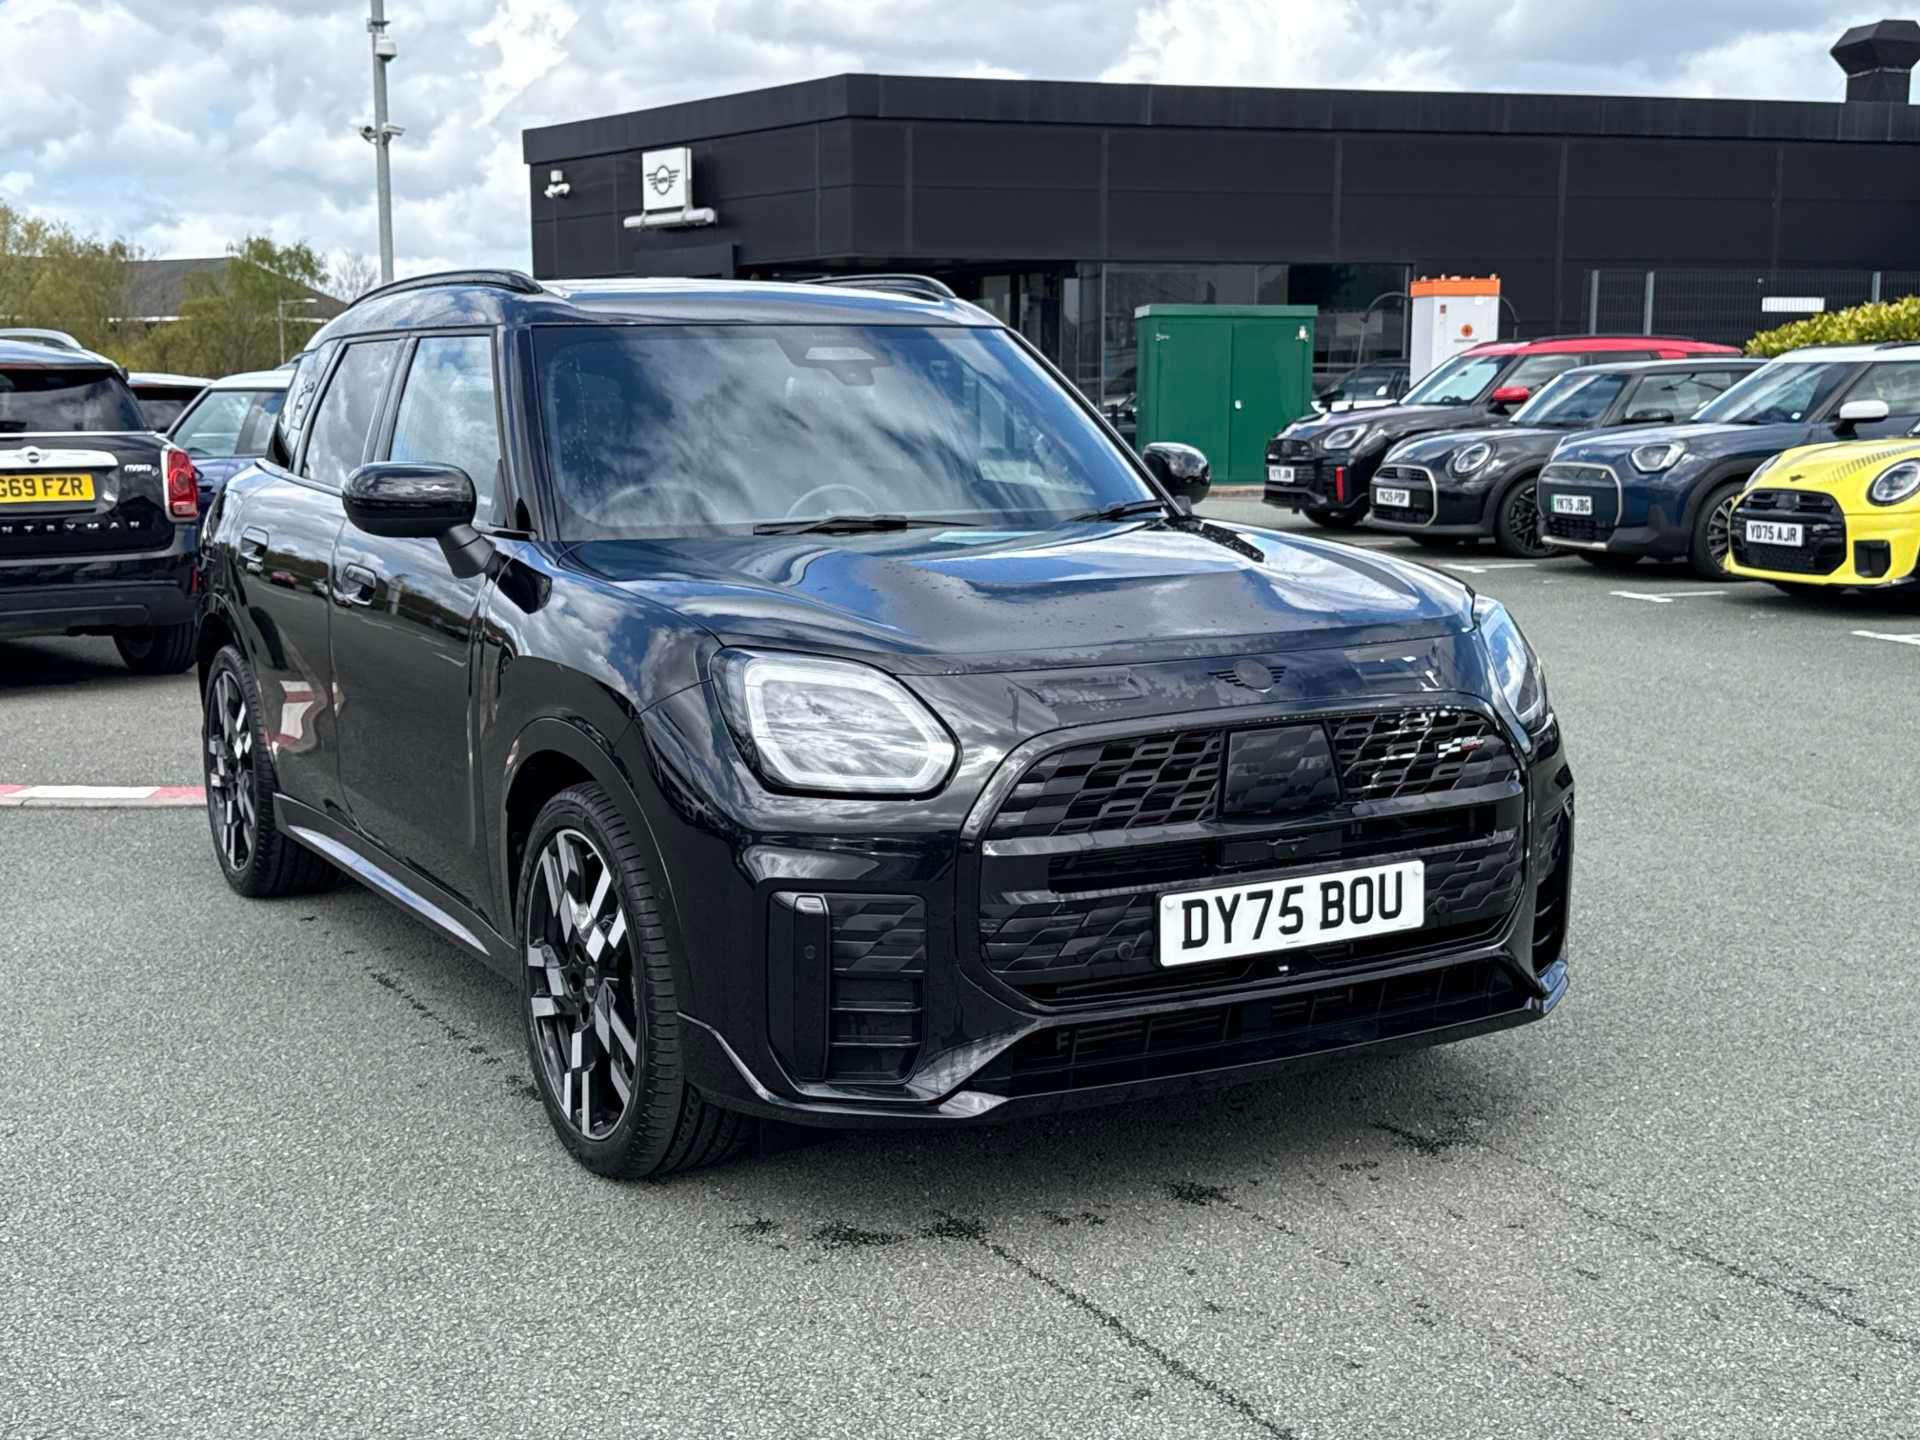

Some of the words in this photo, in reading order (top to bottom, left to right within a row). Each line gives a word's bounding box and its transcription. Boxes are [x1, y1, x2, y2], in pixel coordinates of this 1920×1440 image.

[43, 478, 84, 496] FZR
[1750, 524, 1774, 540] YD75
[1777, 526, 1797, 542] AJR
[1182, 885, 1304, 950] DY75
[1320, 871, 1403, 930] BOU
